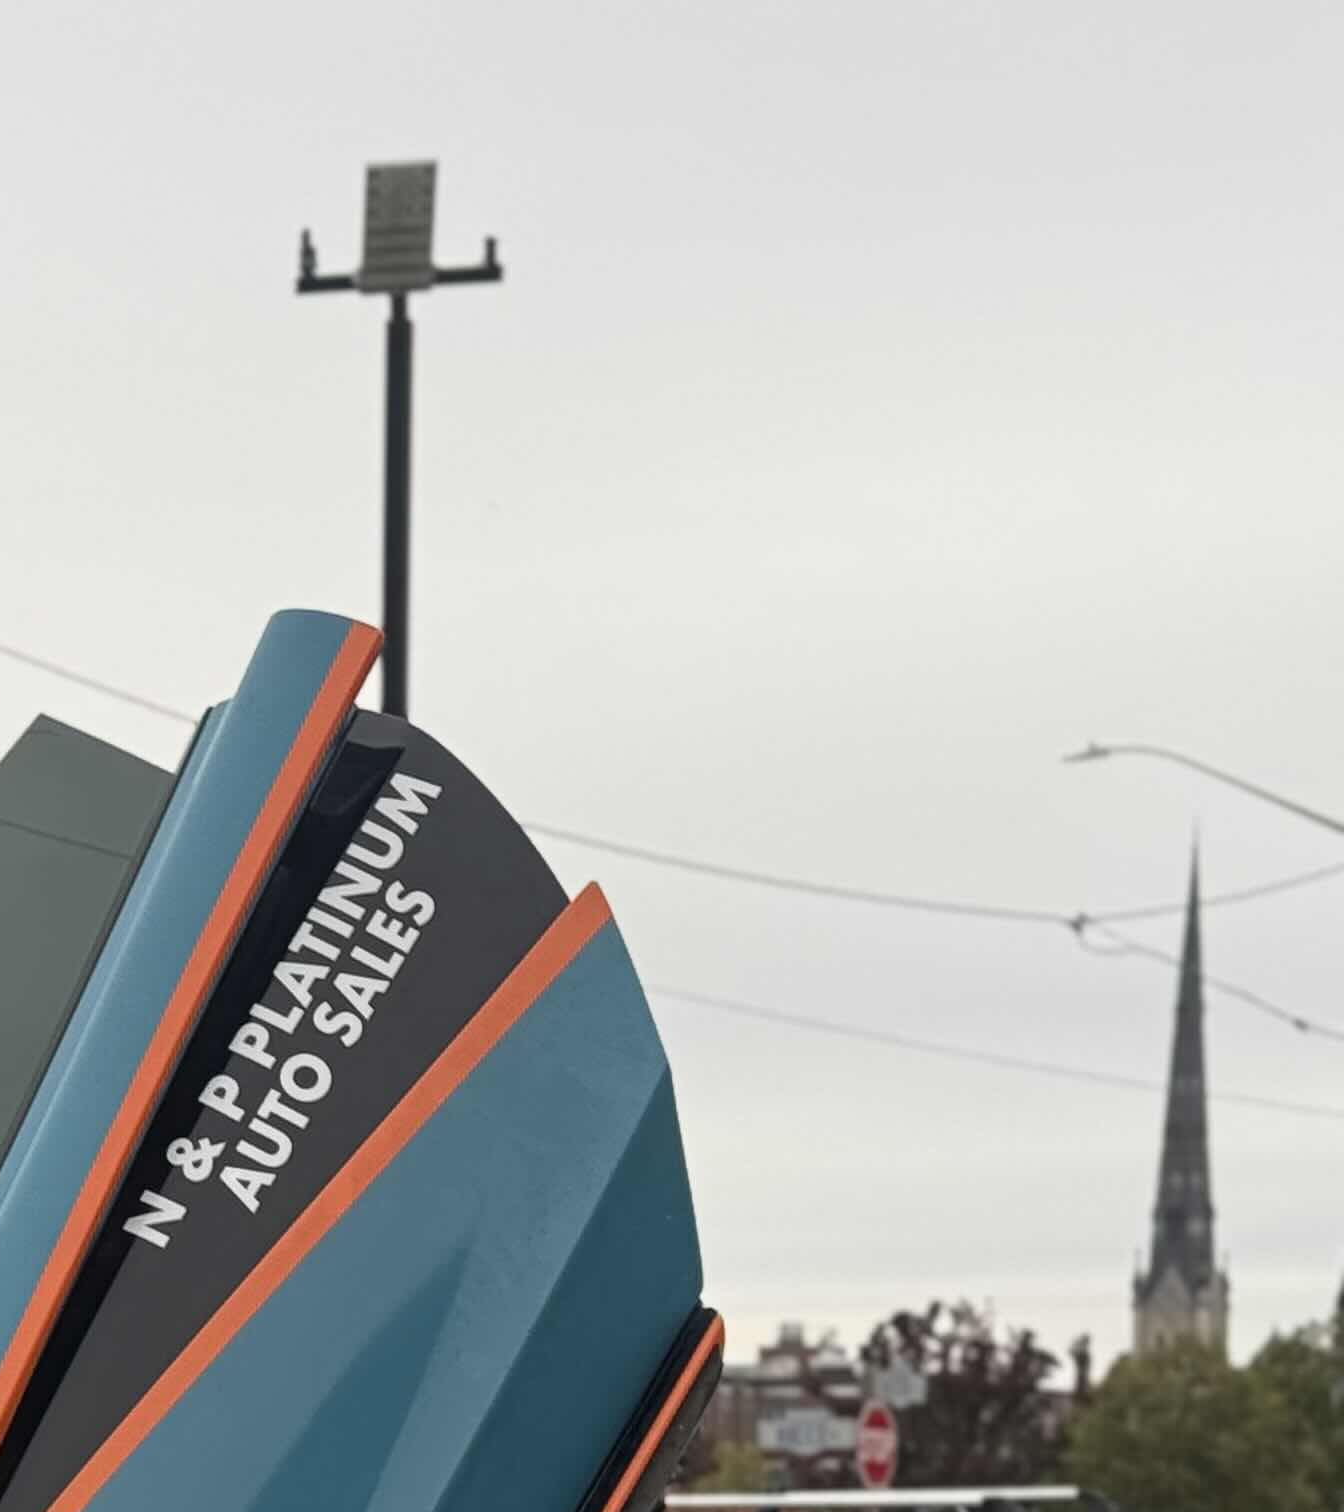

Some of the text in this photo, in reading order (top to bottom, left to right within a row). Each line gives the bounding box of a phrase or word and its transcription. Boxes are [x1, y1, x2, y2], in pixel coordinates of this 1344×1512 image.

[122, 772, 443, 1249] N & P PLATINUM
[219, 879, 437, 1214] AUTO SALES
